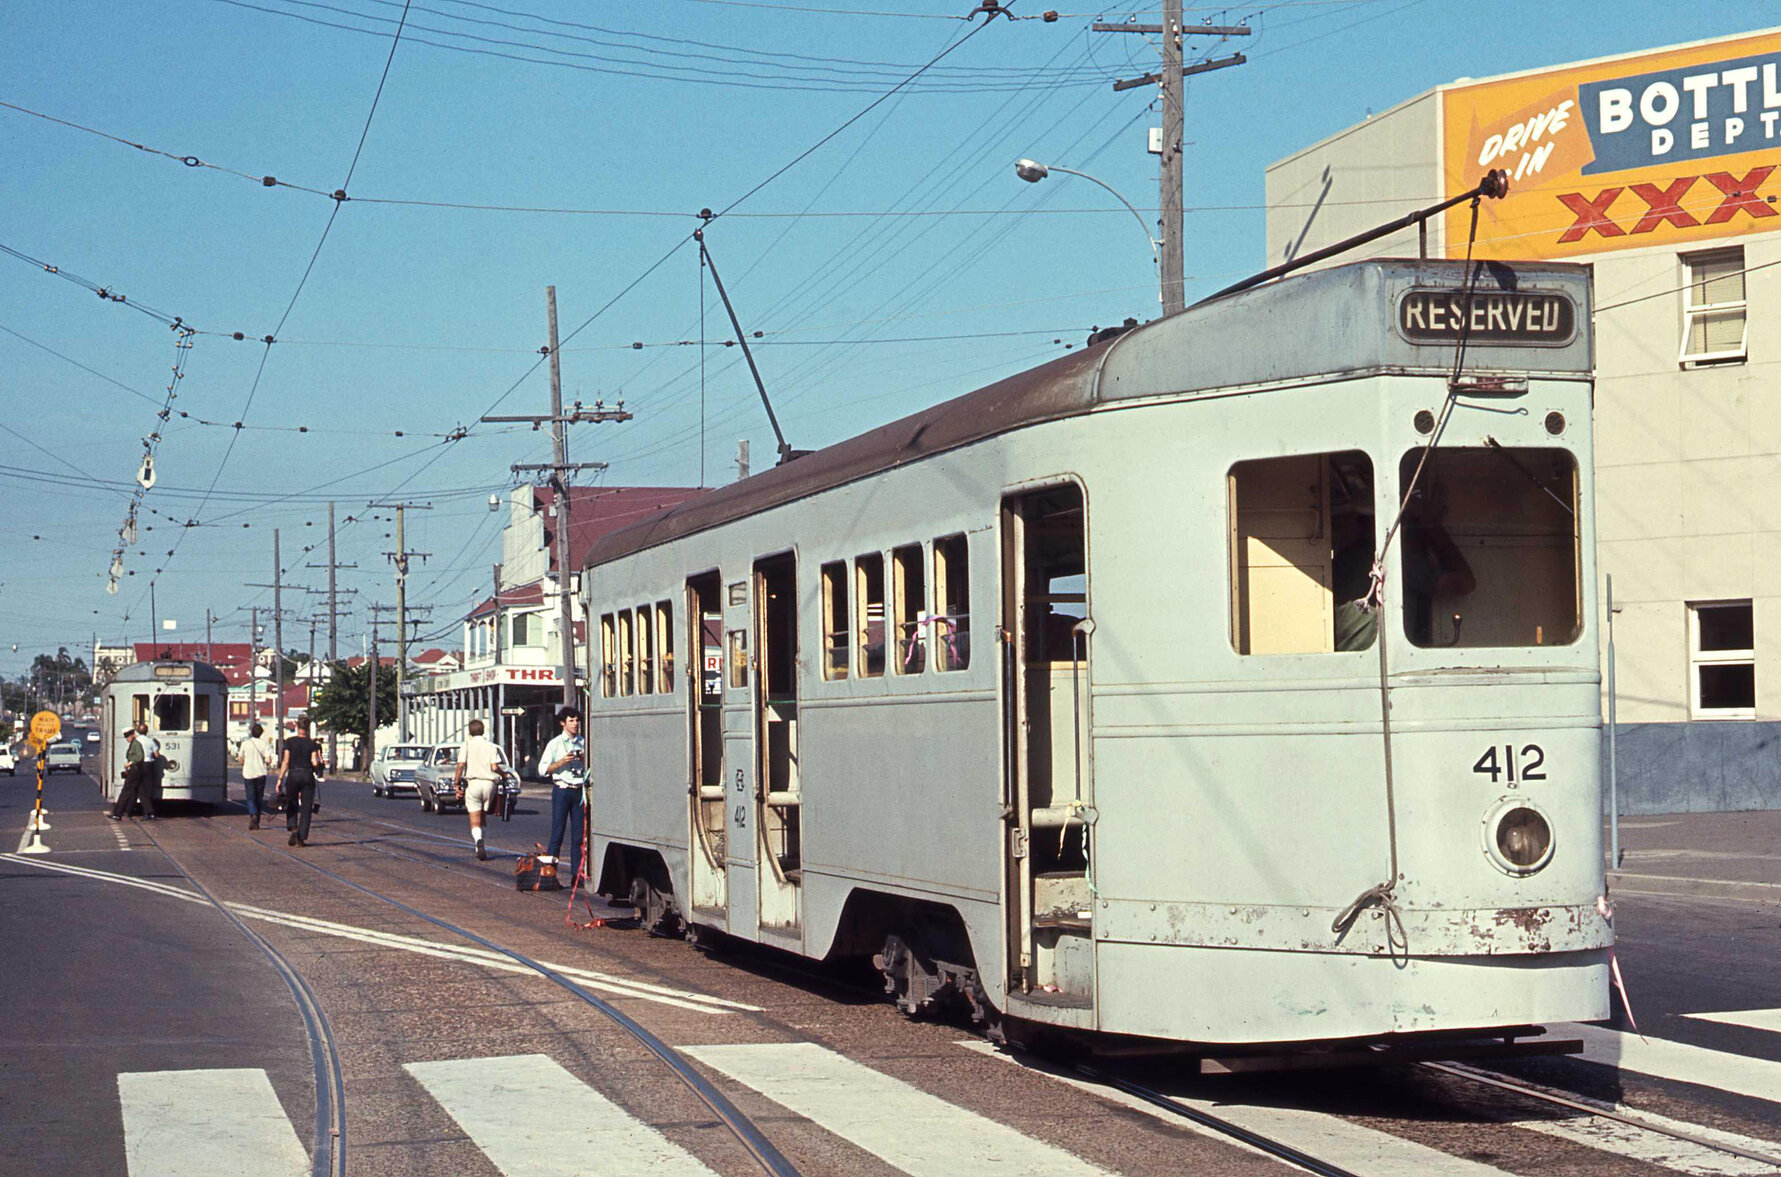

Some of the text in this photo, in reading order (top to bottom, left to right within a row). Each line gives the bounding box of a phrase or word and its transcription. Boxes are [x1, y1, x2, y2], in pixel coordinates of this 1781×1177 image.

[1598, 63, 1781, 134] BOTTL
[1478, 99, 1575, 166] DRIVE
[1405, 295, 1560, 332] RESERVED
[505, 668, 562, 681] THR
[165, 742, 180, 750] 531
[1472, 744, 1547, 783] 412
